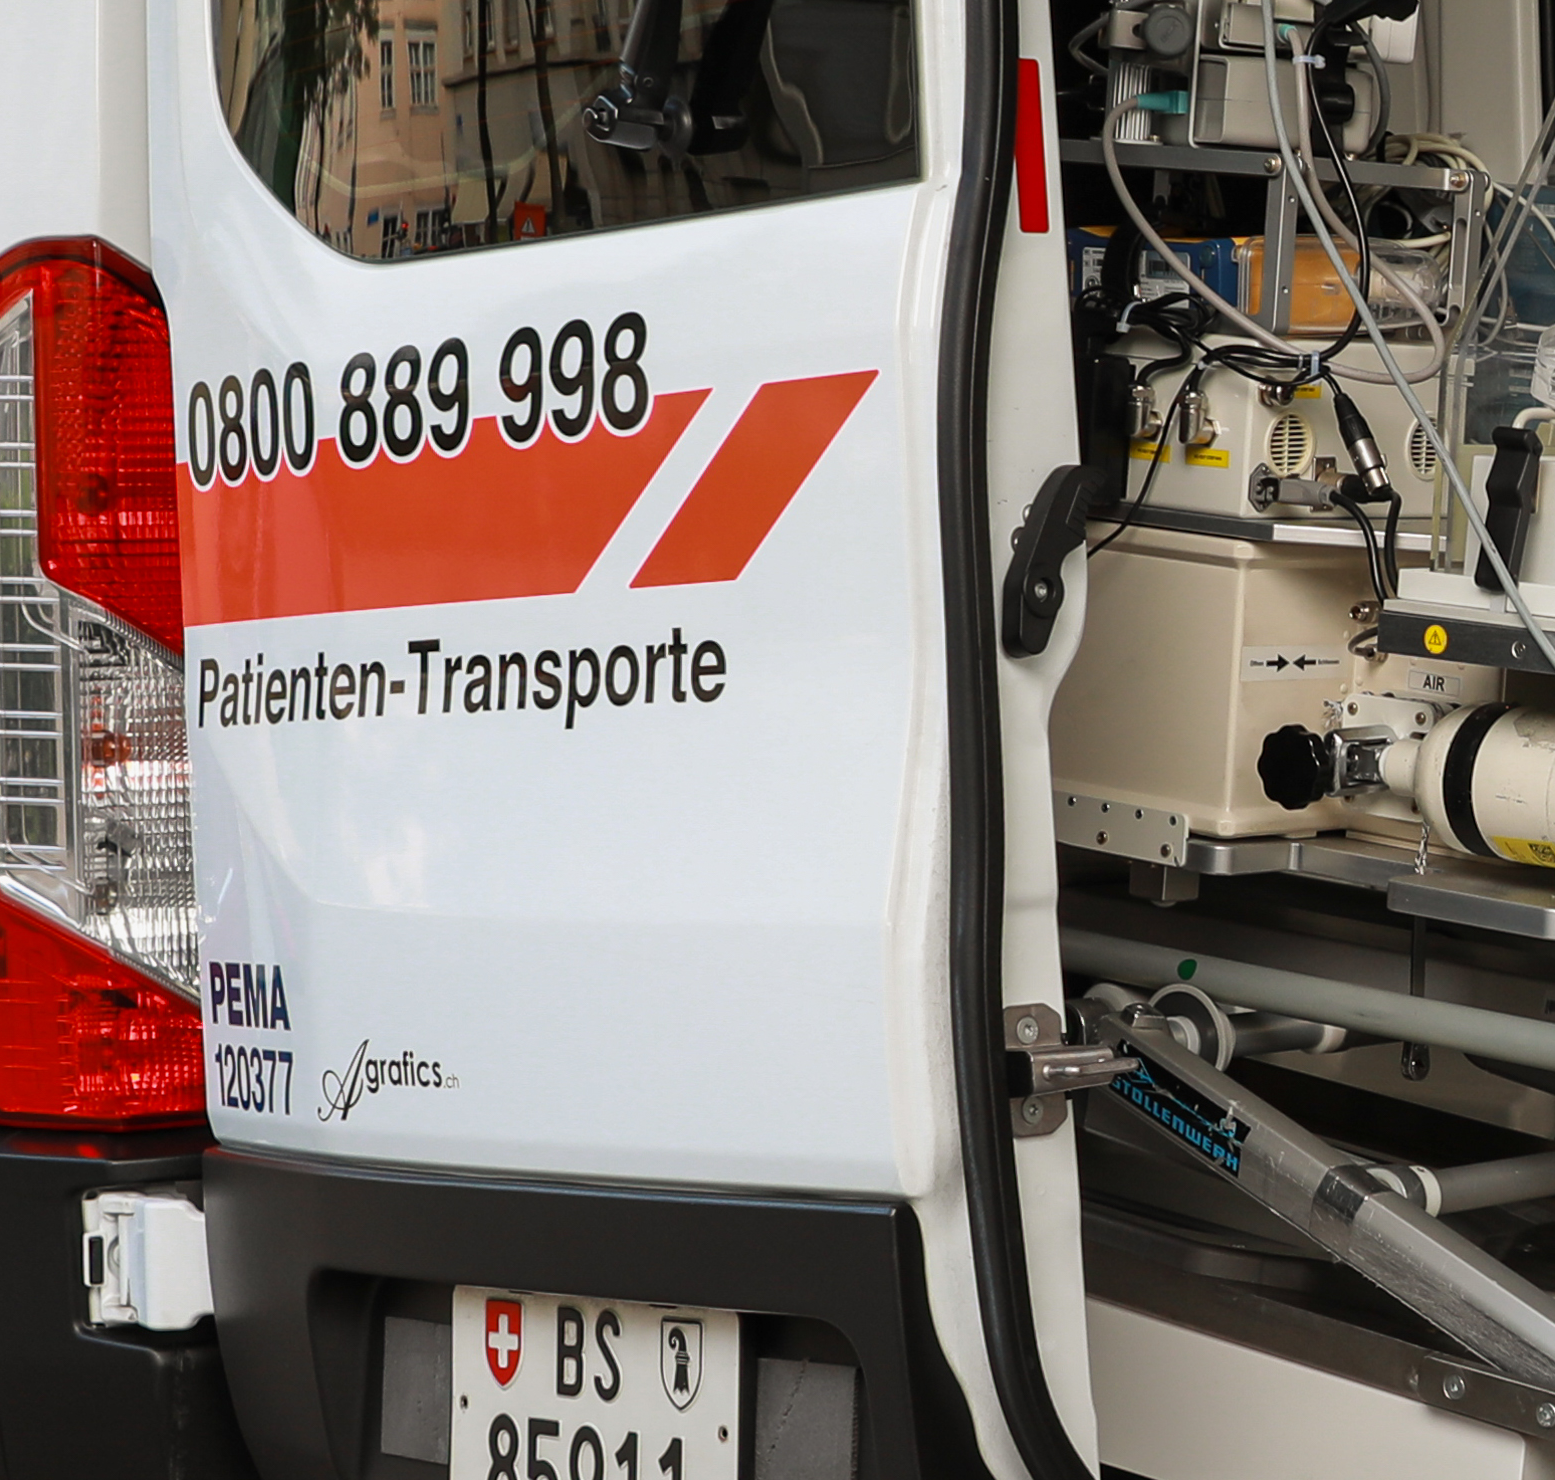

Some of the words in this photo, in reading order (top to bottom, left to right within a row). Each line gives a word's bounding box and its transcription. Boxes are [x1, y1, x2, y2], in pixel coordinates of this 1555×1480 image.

[187, 360, 315, 486] 0800
[338, 337, 469, 463] 889
[499, 311, 648, 444] 998
[197, 627, 727, 730] Patienten-Transporte
[1422, 674, 1445, 692] AIR
[209, 961, 292, 1031] PEMA
[214, 1043, 294, 1116] 120377
[556, 1305, 621, 1402] BS
